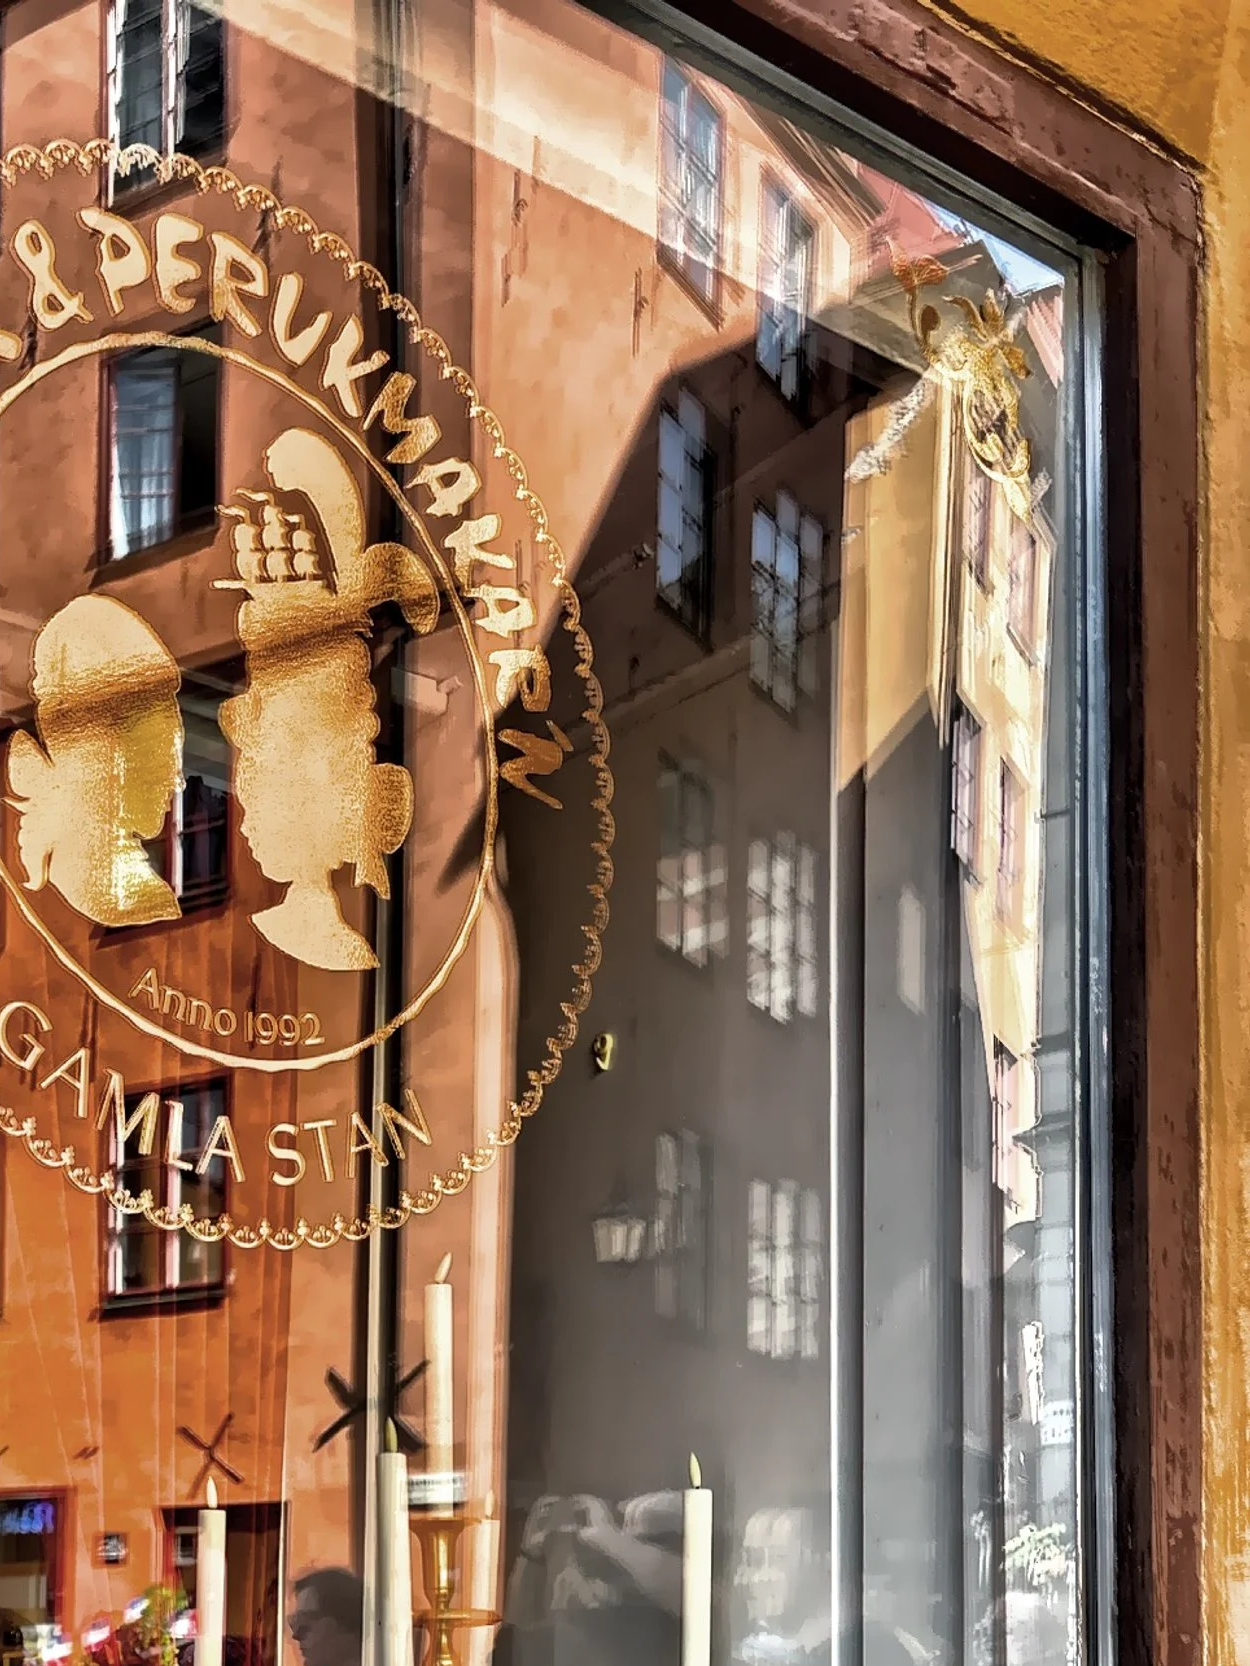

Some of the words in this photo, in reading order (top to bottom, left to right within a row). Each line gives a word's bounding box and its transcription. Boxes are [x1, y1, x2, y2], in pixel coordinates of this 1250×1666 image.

[11, 218, 95, 333] &
[127, 966, 238, 1038] Anno
[244, 1009, 326, 1047] 1992
[268, 1087, 433, 1187] STAN
